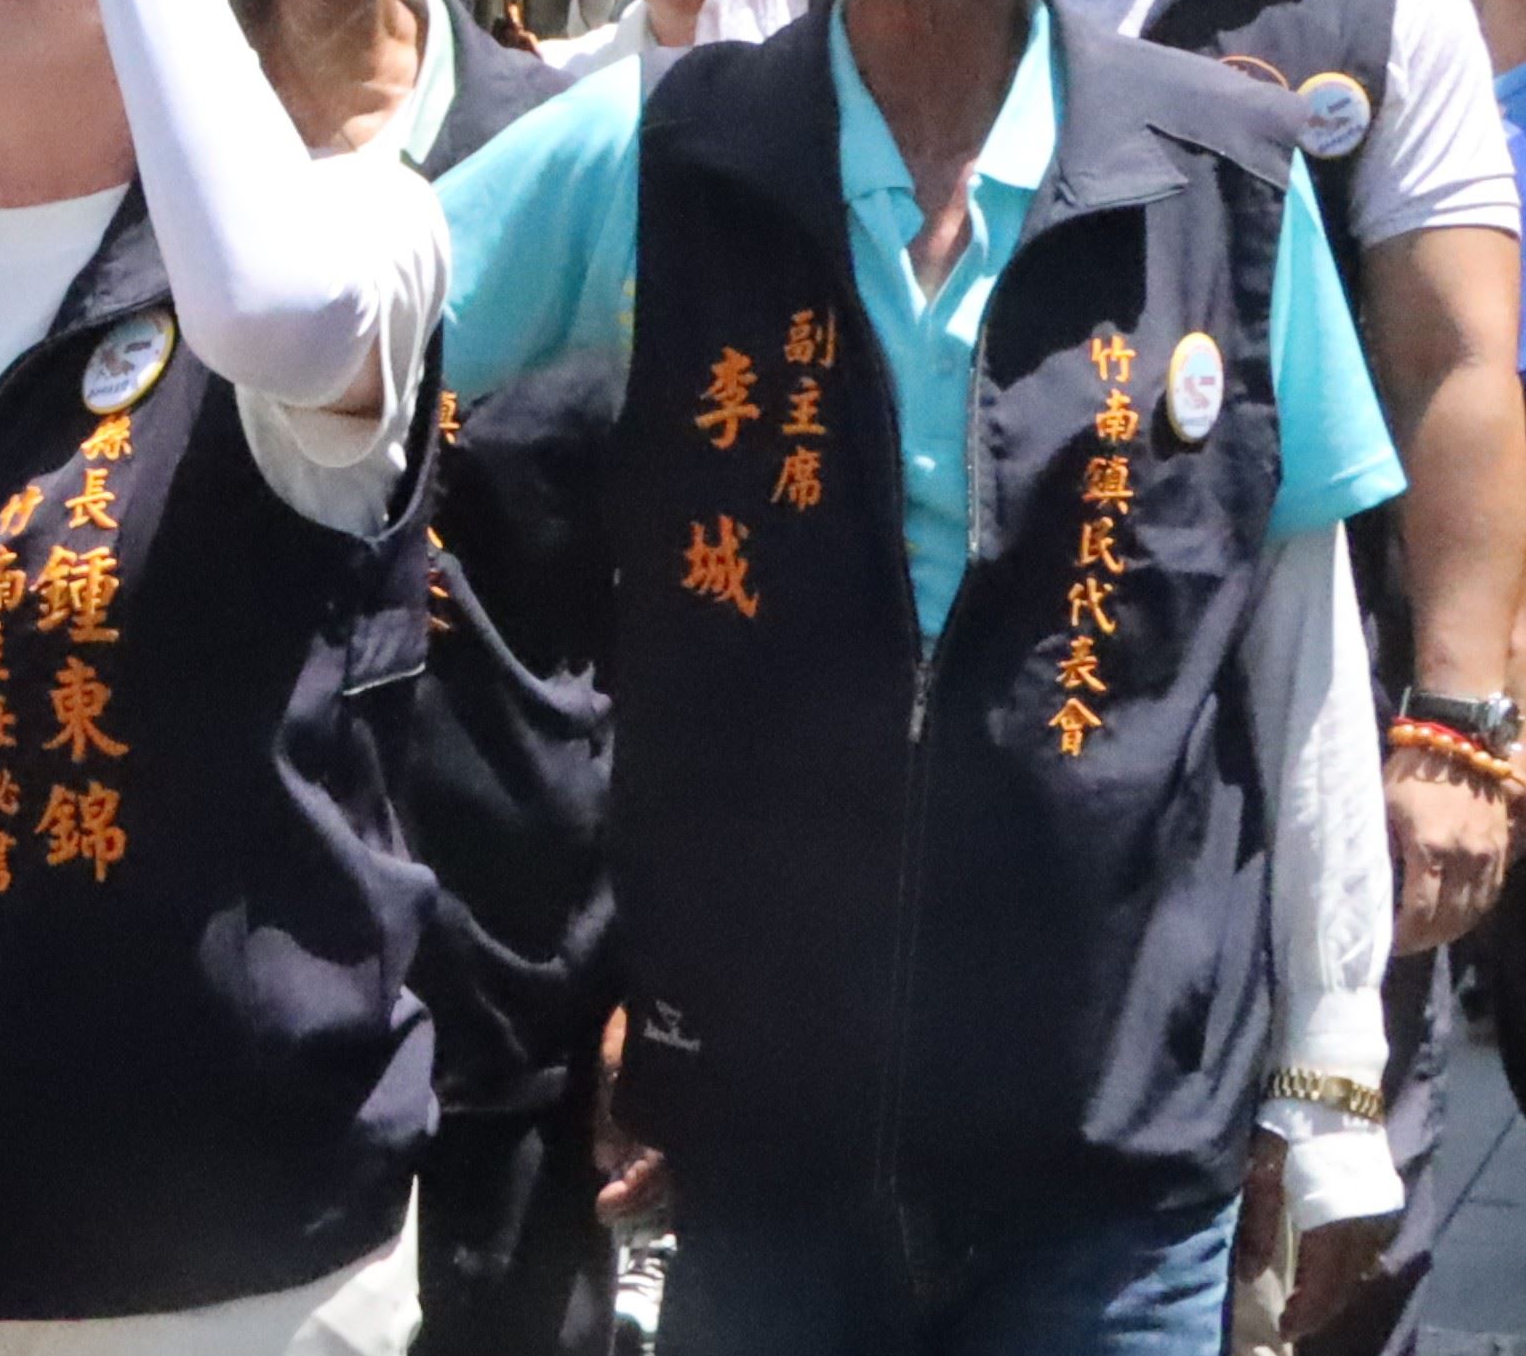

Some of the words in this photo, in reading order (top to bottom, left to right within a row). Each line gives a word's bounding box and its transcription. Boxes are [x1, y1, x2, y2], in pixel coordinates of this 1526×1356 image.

[770, 307, 836, 511] 副主席
[1048, 335, 1139, 757] 竹南鎮民代表會
